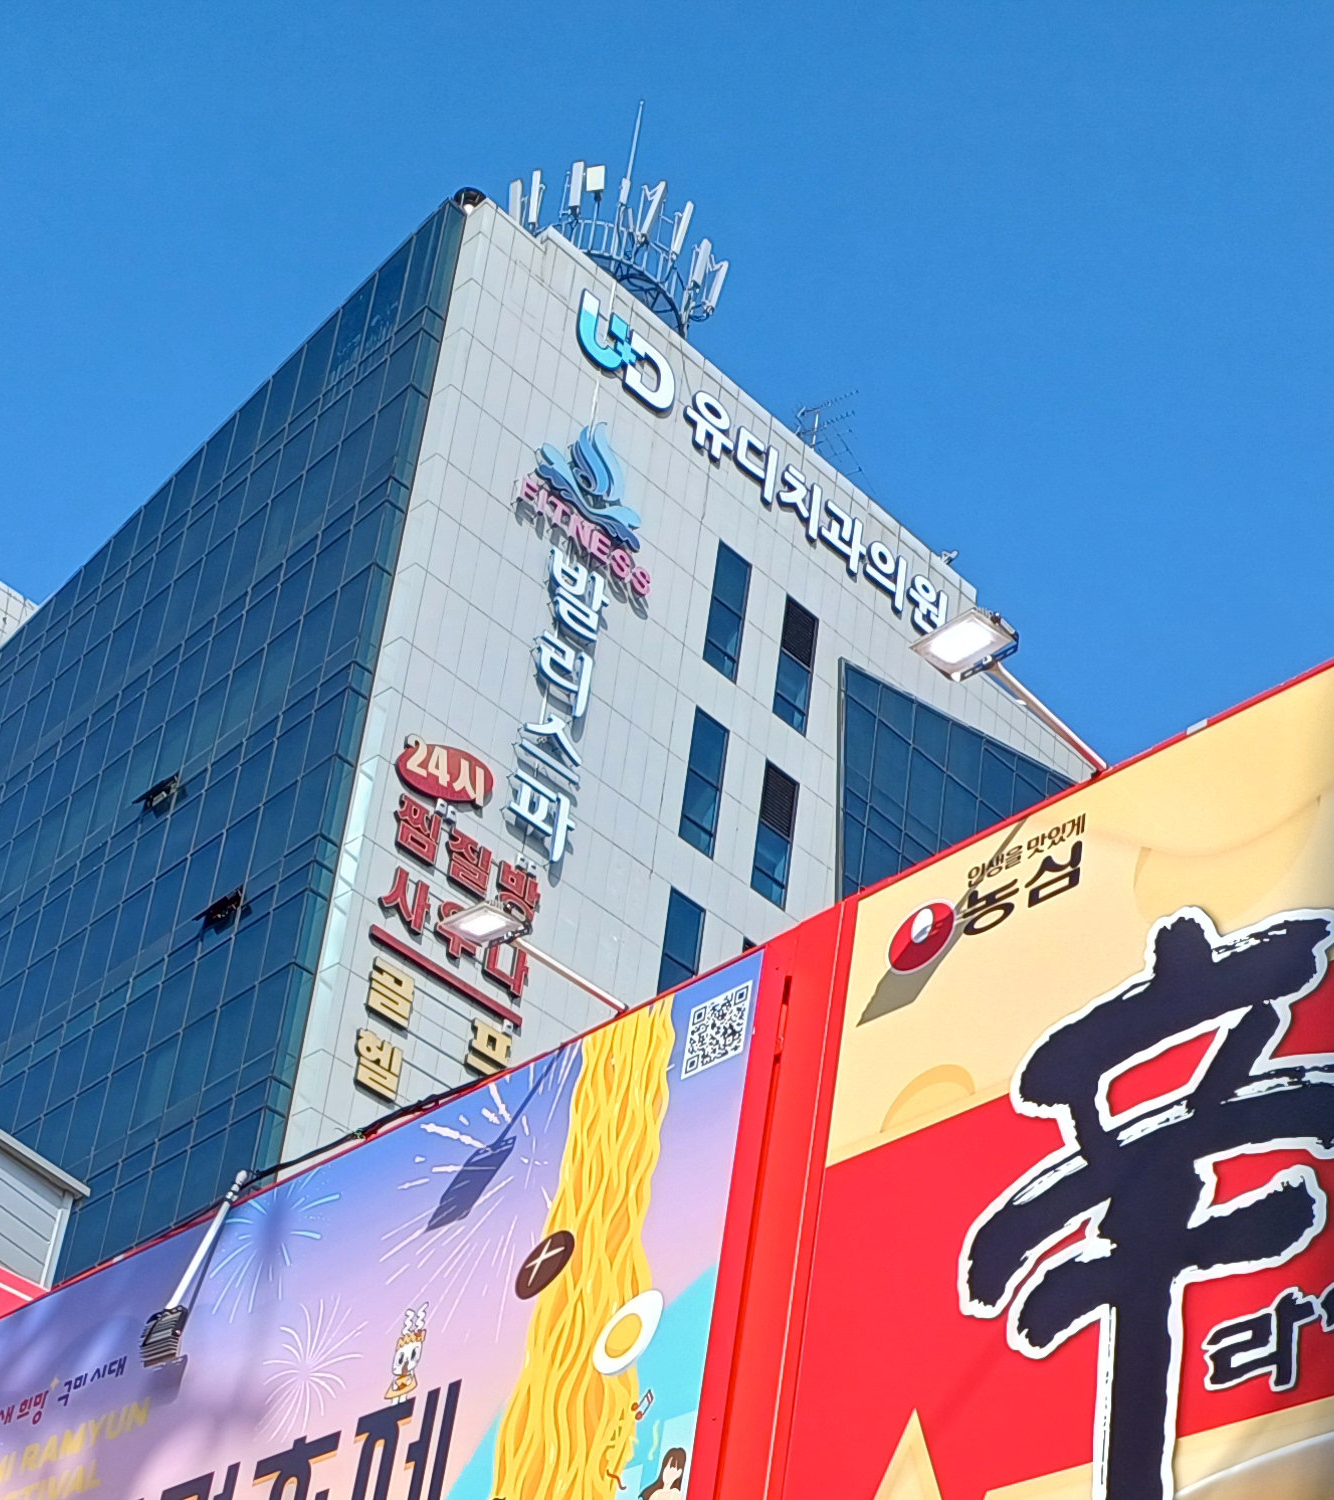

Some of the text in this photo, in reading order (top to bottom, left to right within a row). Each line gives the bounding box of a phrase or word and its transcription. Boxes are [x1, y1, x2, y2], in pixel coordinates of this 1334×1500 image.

[520, 476, 651, 597] FITNESS
[686, 391, 948, 634] 유디치과의원
[405, 734, 485, 806] 24시
[396, 793, 542, 928] 찜질방
[963, 841, 1082, 936] 농심
[967, 813, 1086, 888] 인생을 맛있게
[17, 1390, 49, 1425] 희망
[58, 1373, 87, 1407] 구미
[90, 1356, 127, 1383] 시대
[20, 1397, 152, 1472] RAMYUN
